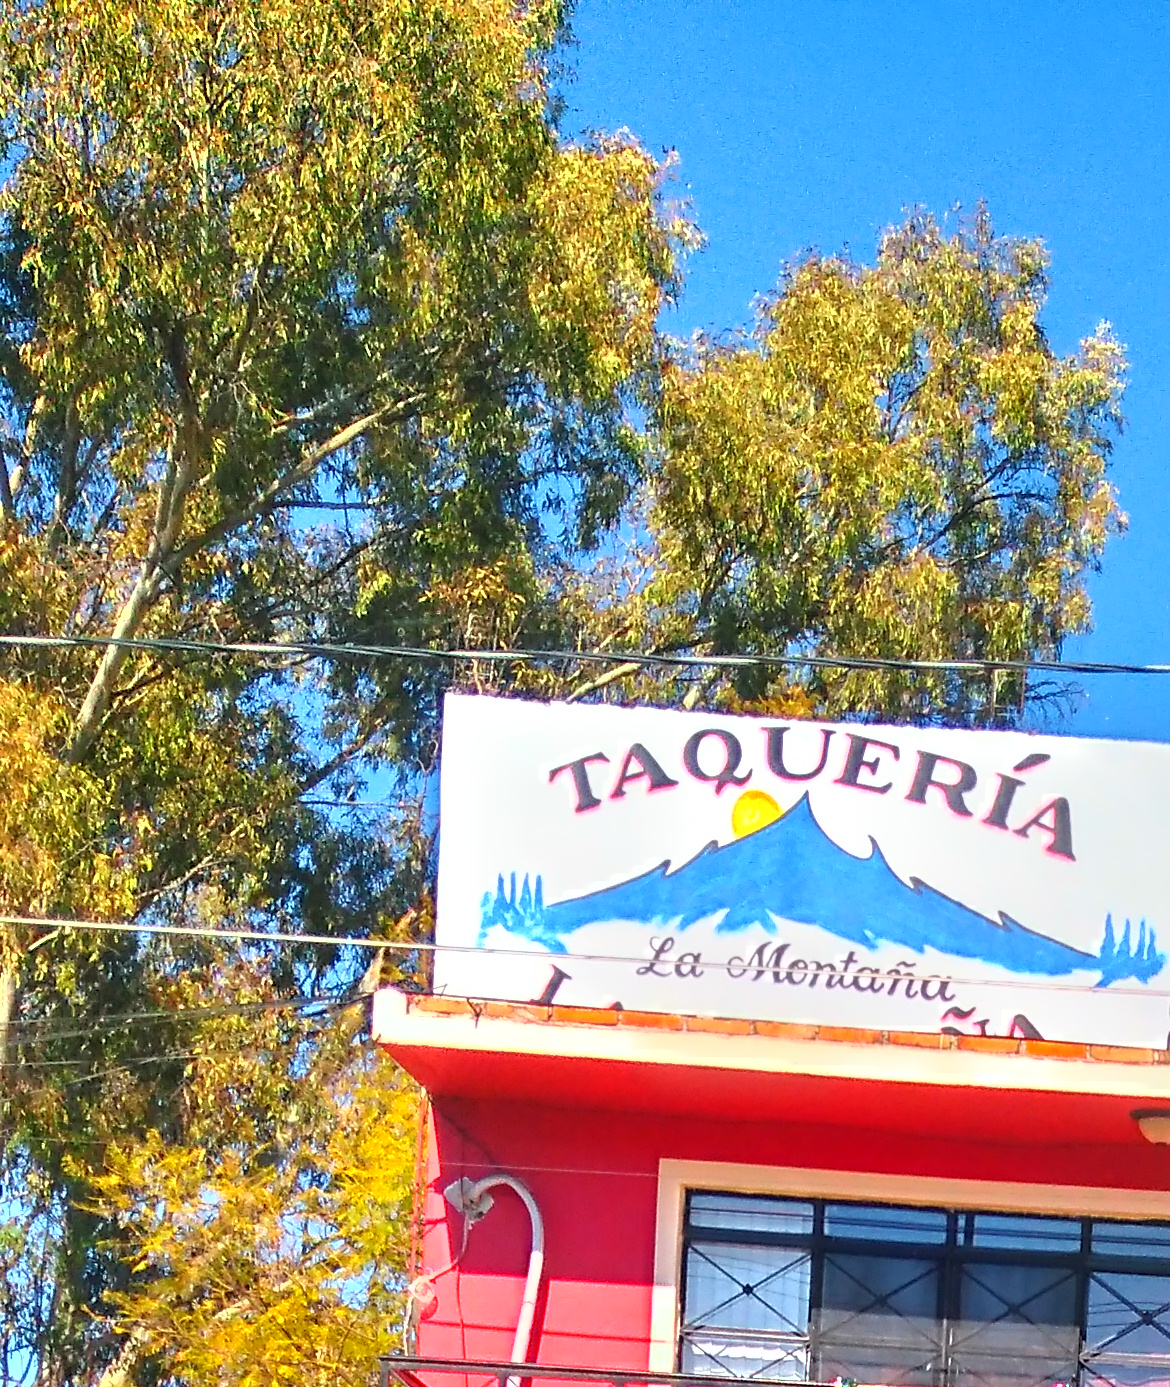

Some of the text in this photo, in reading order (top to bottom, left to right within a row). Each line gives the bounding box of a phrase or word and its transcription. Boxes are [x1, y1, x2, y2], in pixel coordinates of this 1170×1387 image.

[548, 726, 1077, 862] TAQUERÍA
[636, 936, 955, 1002] La Montaña
